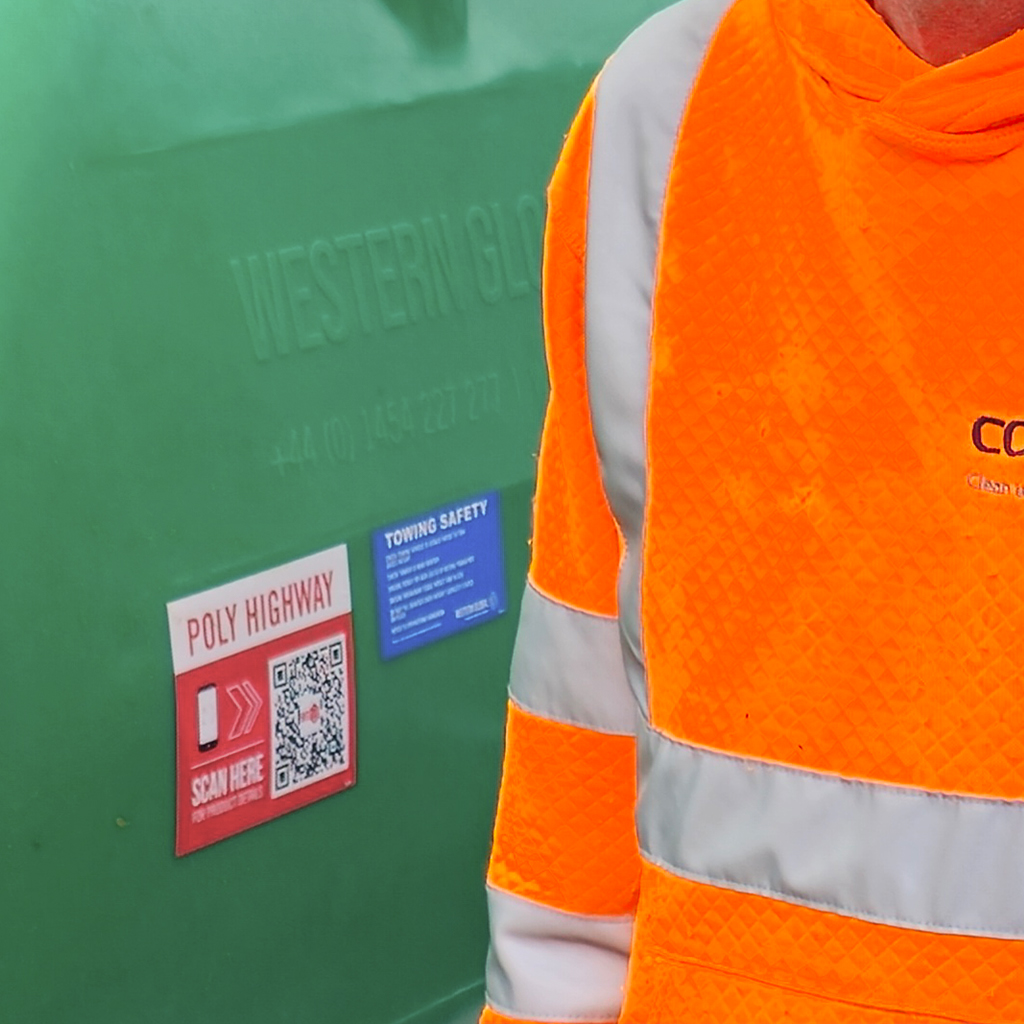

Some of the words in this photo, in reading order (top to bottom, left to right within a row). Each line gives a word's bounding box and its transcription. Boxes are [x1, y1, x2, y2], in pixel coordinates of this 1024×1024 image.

[230, 212, 466, 362] WESTERN
[384, 517, 437, 549] TOWING
[439, 499, 488, 530] SAFETY
[187, 603, 237, 656] POLY
[245, 570, 334, 636] HIGHWAY
[191, 767, 228, 807] SCAN
[229, 753, 264, 792] HERE
